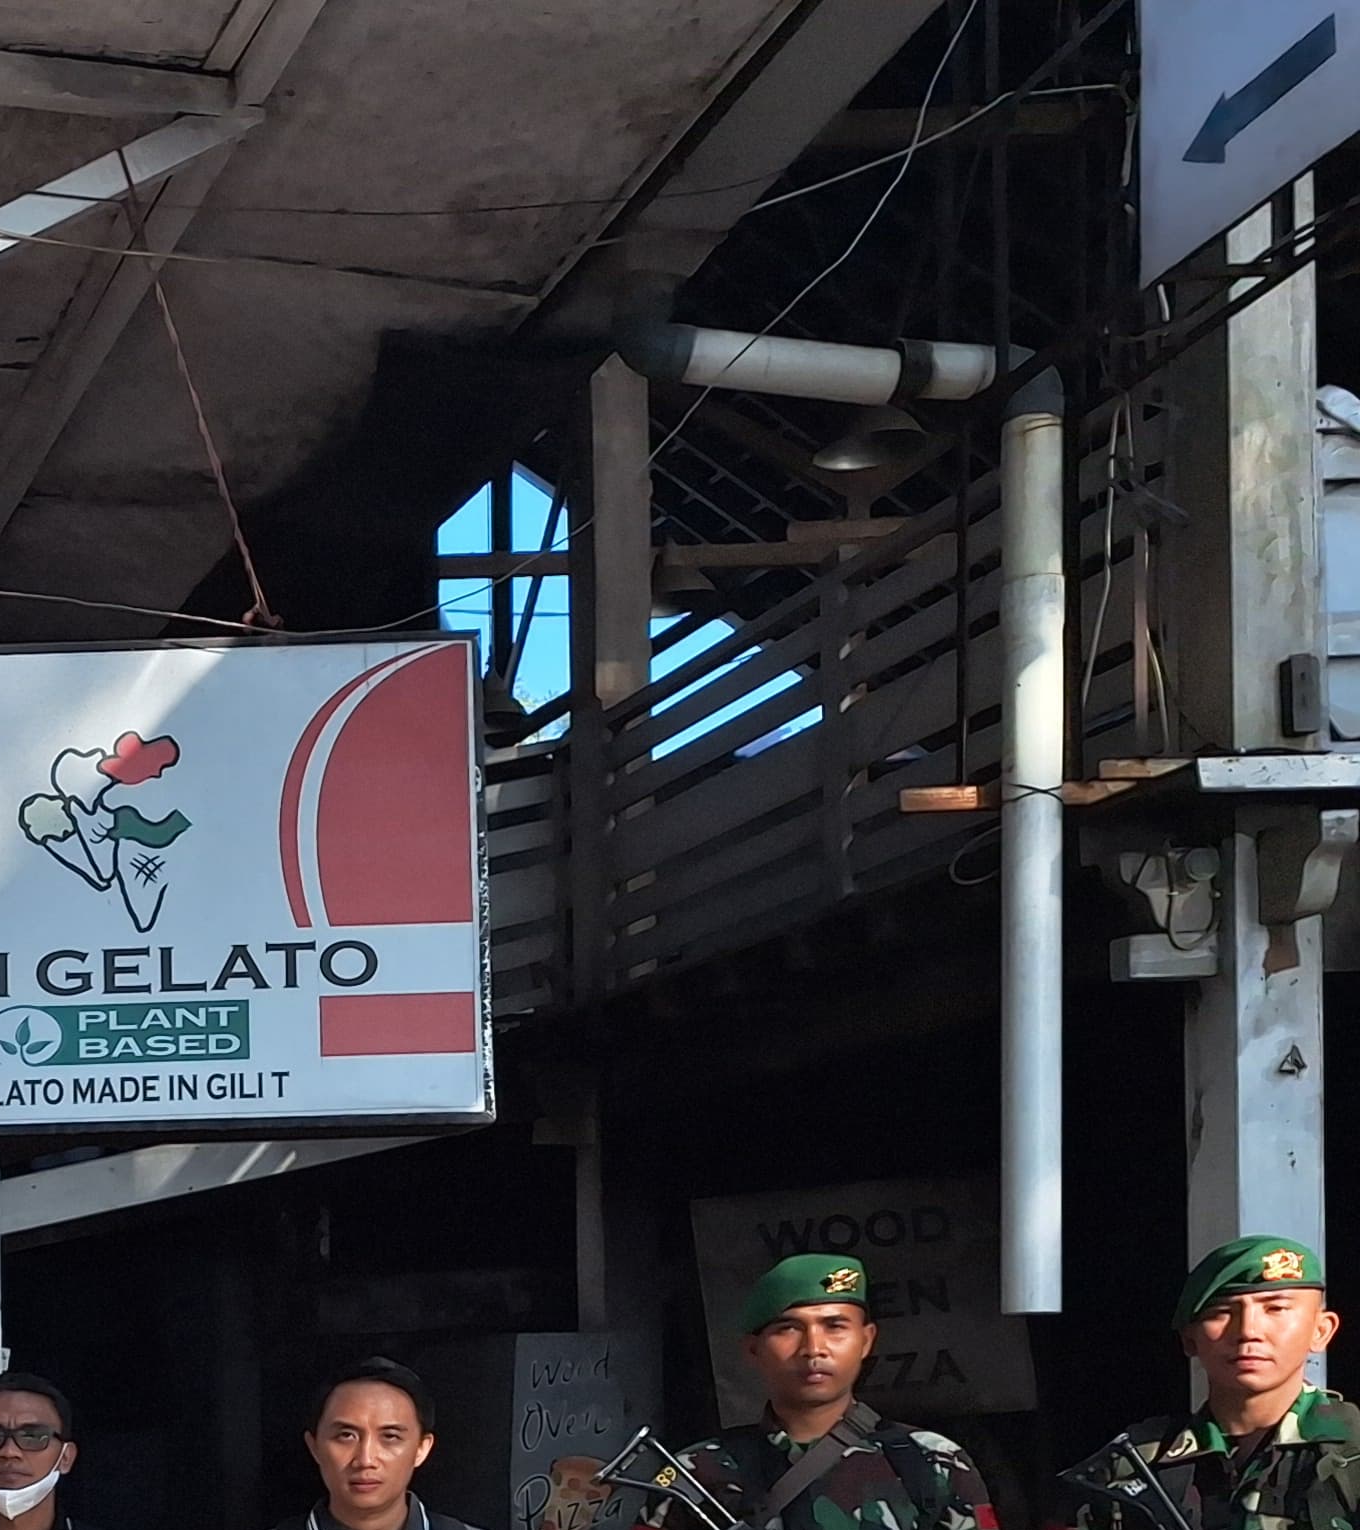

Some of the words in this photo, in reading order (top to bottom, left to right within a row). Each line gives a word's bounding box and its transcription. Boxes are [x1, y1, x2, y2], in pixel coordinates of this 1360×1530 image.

[36, 940, 378, 997] GELATO
[78, 1006, 239, 1032] PLANT
[78, 1033, 241, 1059] BASED
[73, 1075, 161, 1104] MADE
[168, 1073, 198, 1101] IN
[206, 1072, 263, 1100] GILI
[270, 1070, 290, 1098] T
[757, 1206, 950, 1252] WOOD
[871, 1278, 951, 1319] EN
